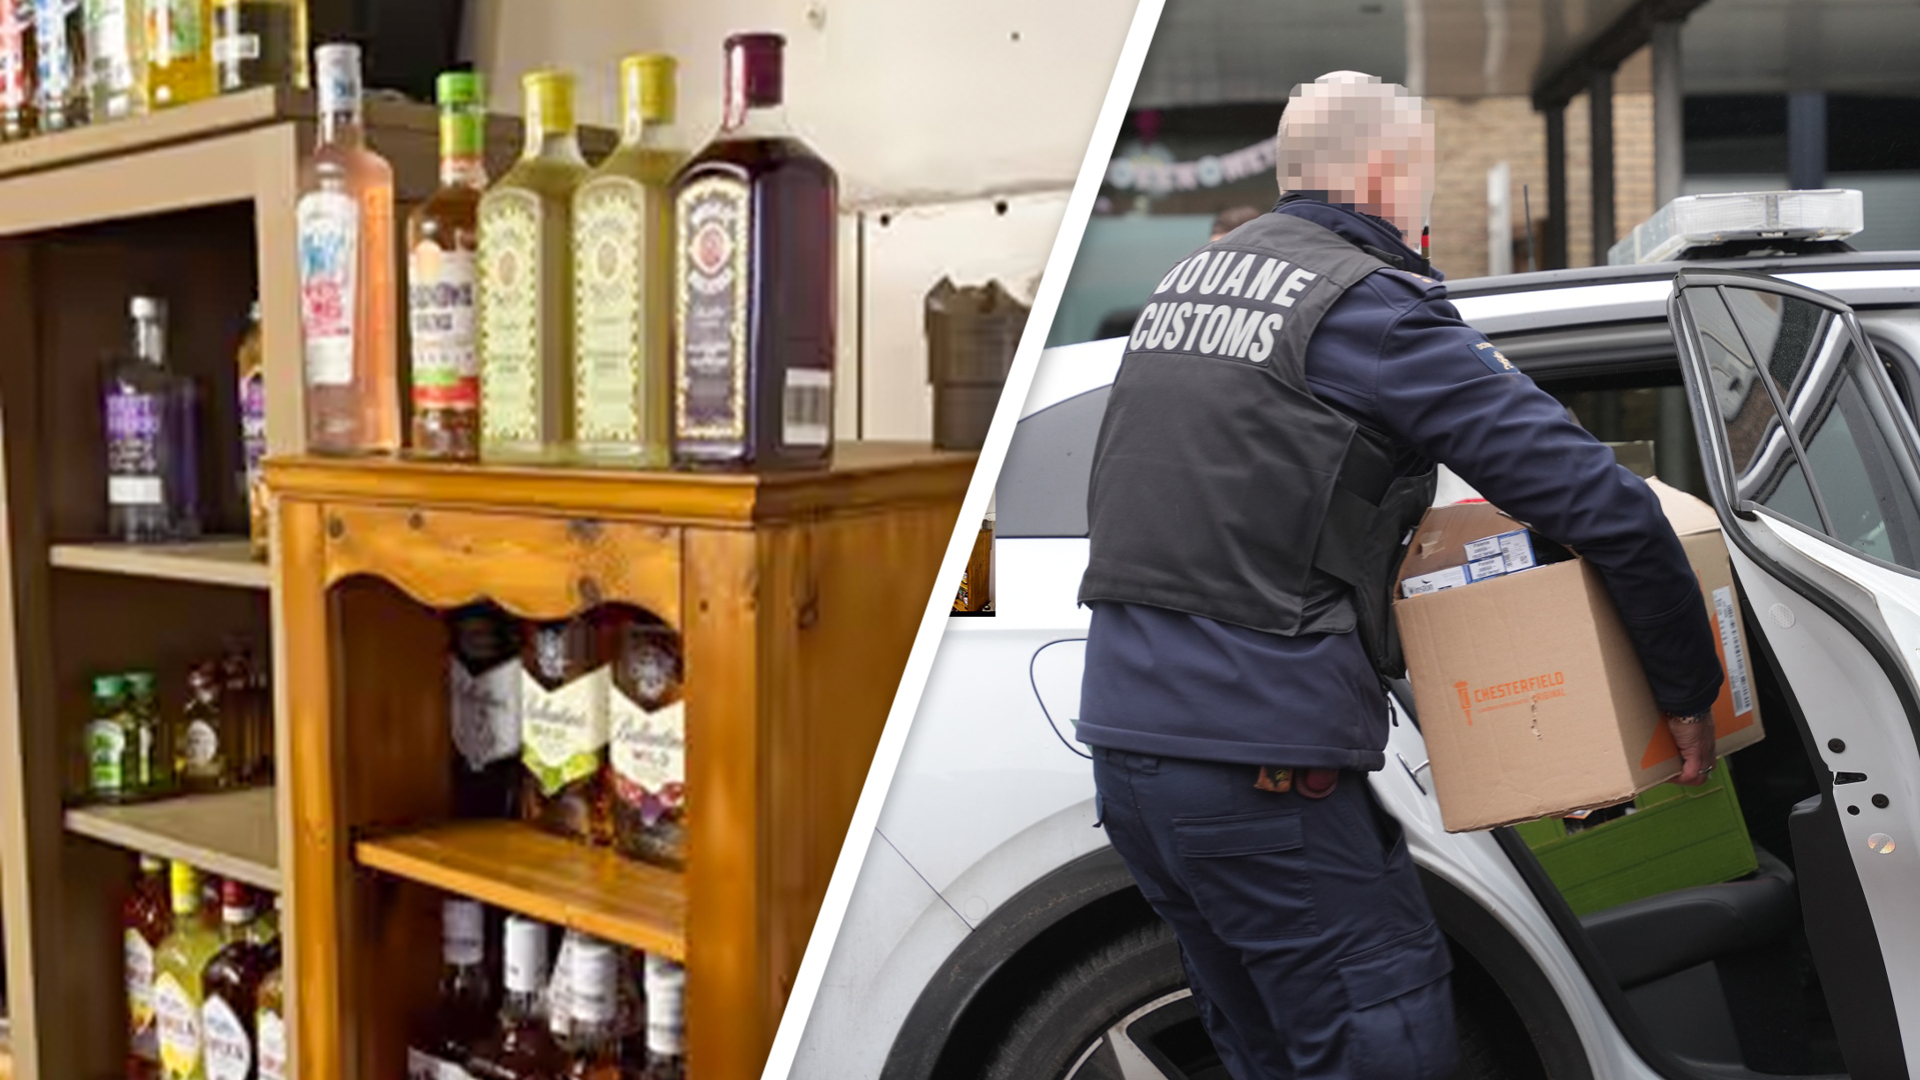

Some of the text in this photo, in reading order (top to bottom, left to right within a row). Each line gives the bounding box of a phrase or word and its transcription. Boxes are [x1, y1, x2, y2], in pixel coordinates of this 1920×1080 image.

[1154, 251, 1318, 307] DOUANE
[1129, 302, 1284, 363] CUSTOMS
[1408, 582, 1434, 595] Winston
[1474, 671, 1565, 703] CHESTERFIELD
